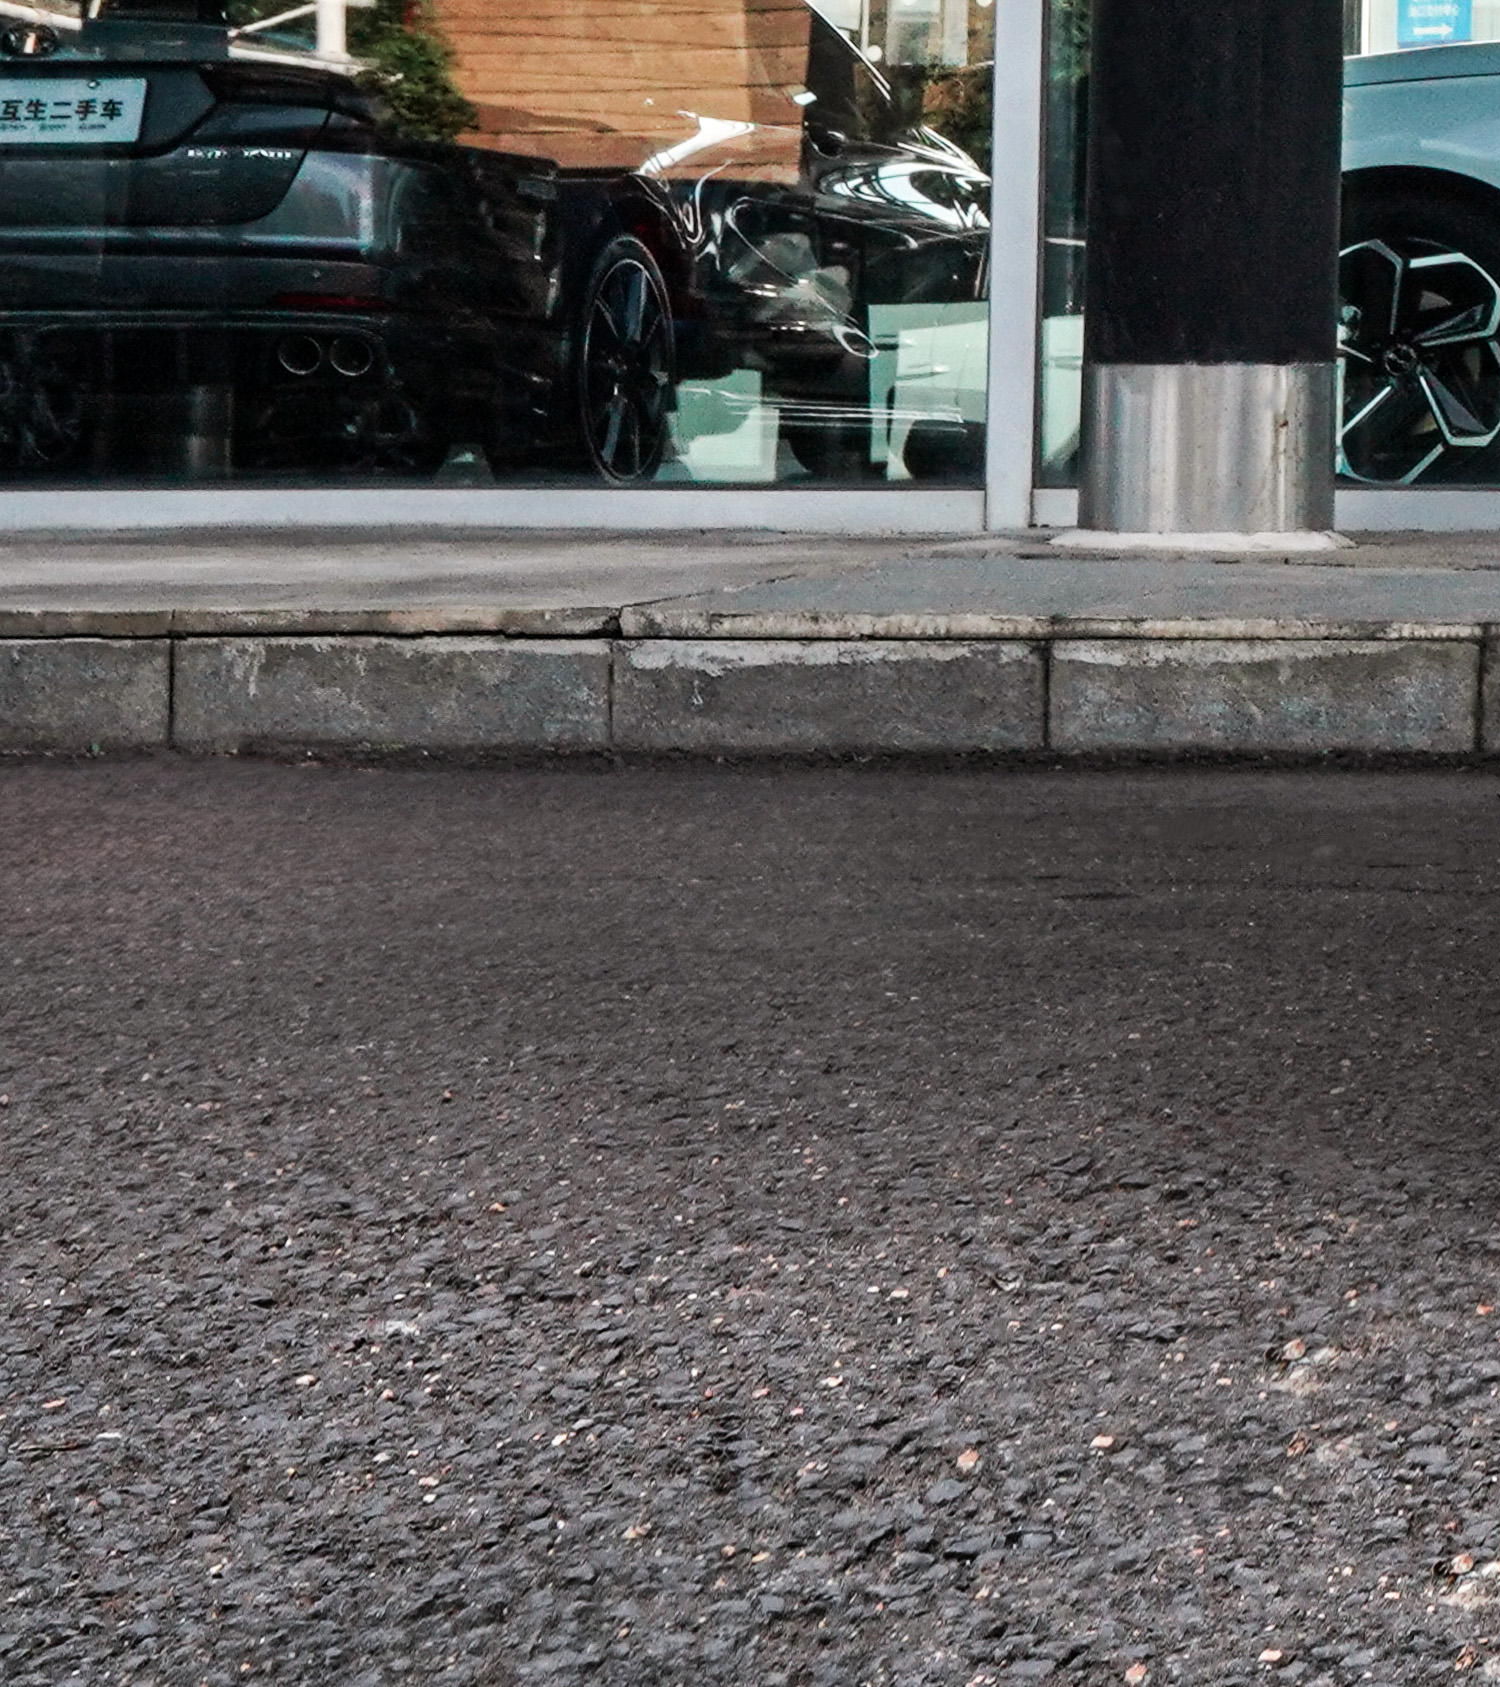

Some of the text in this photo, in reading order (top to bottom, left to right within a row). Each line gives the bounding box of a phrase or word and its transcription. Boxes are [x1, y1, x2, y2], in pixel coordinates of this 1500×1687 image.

[0, 98, 123, 121] 互生二手车
